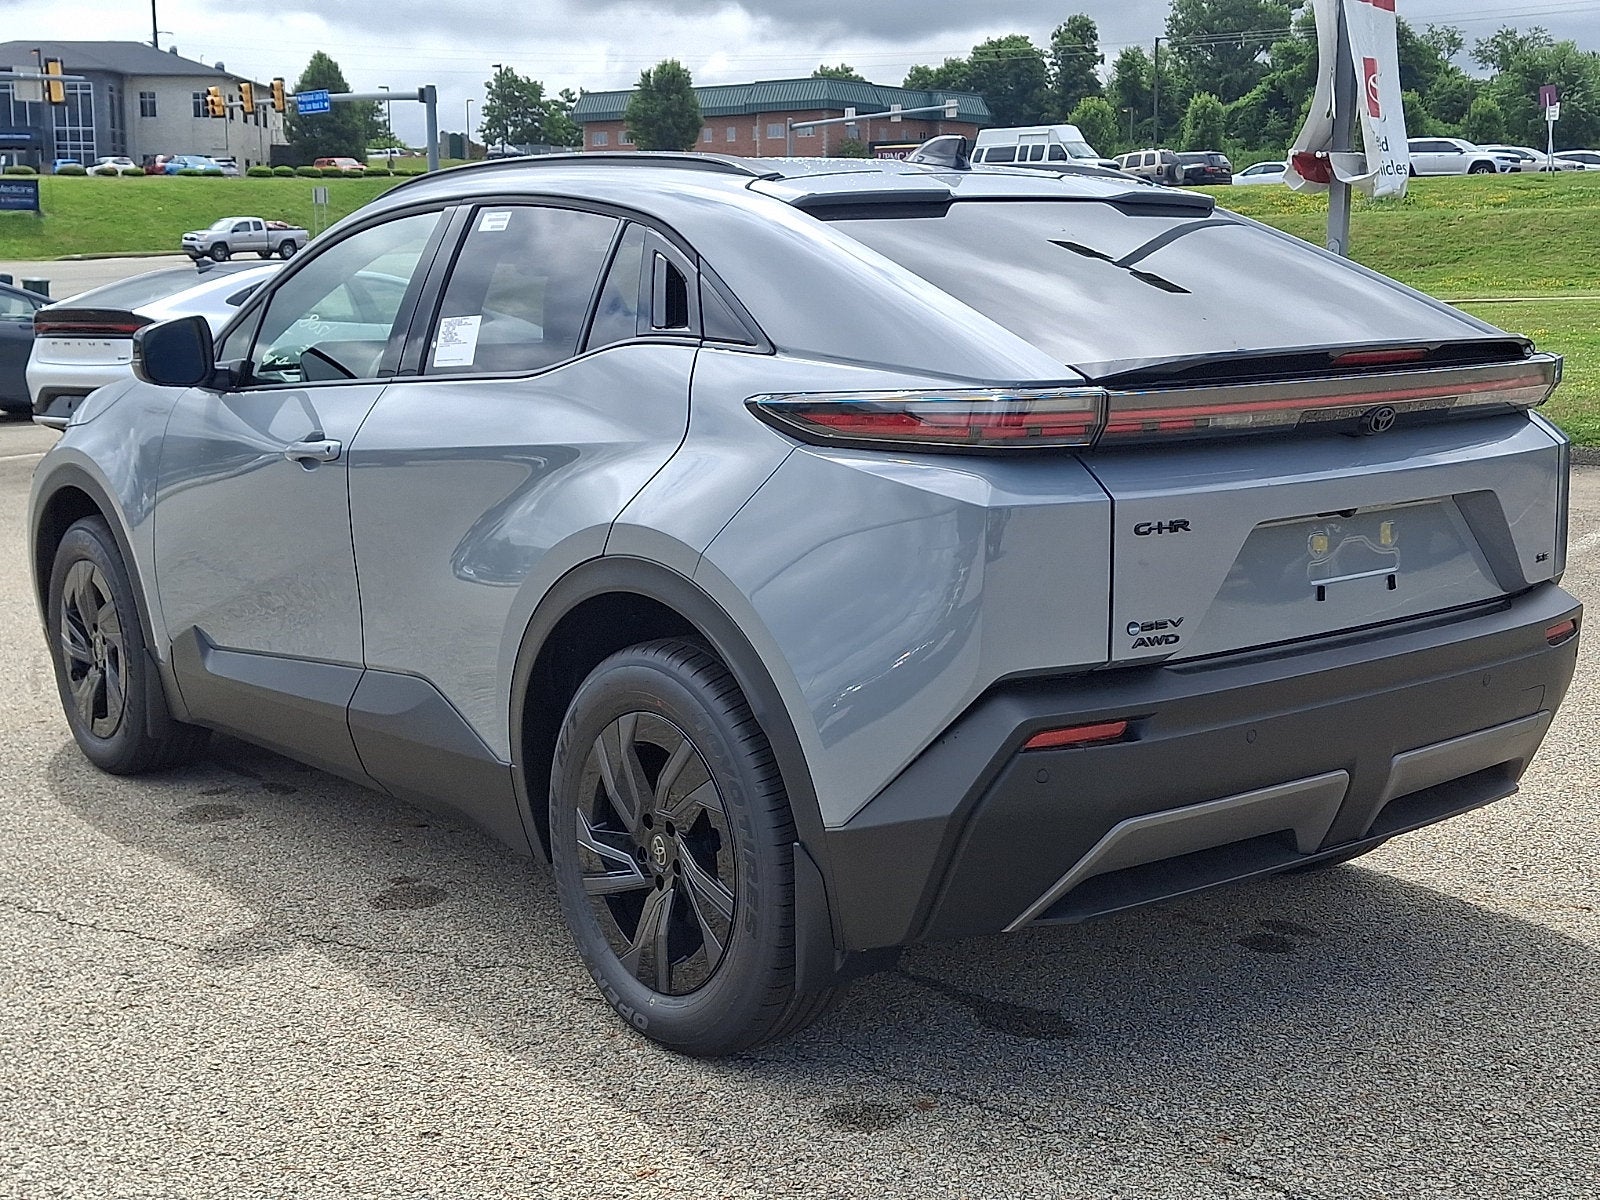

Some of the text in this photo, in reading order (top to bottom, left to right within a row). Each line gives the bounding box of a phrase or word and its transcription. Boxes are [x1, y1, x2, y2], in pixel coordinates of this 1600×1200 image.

[1134, 519, 1191, 535] C-HR
[1141, 617, 1184, 632] BEV
[1132, 634, 1180, 649] AWD
[738, 813, 759, 940] TIRES
[591, 967, 649, 1030] OPEN
